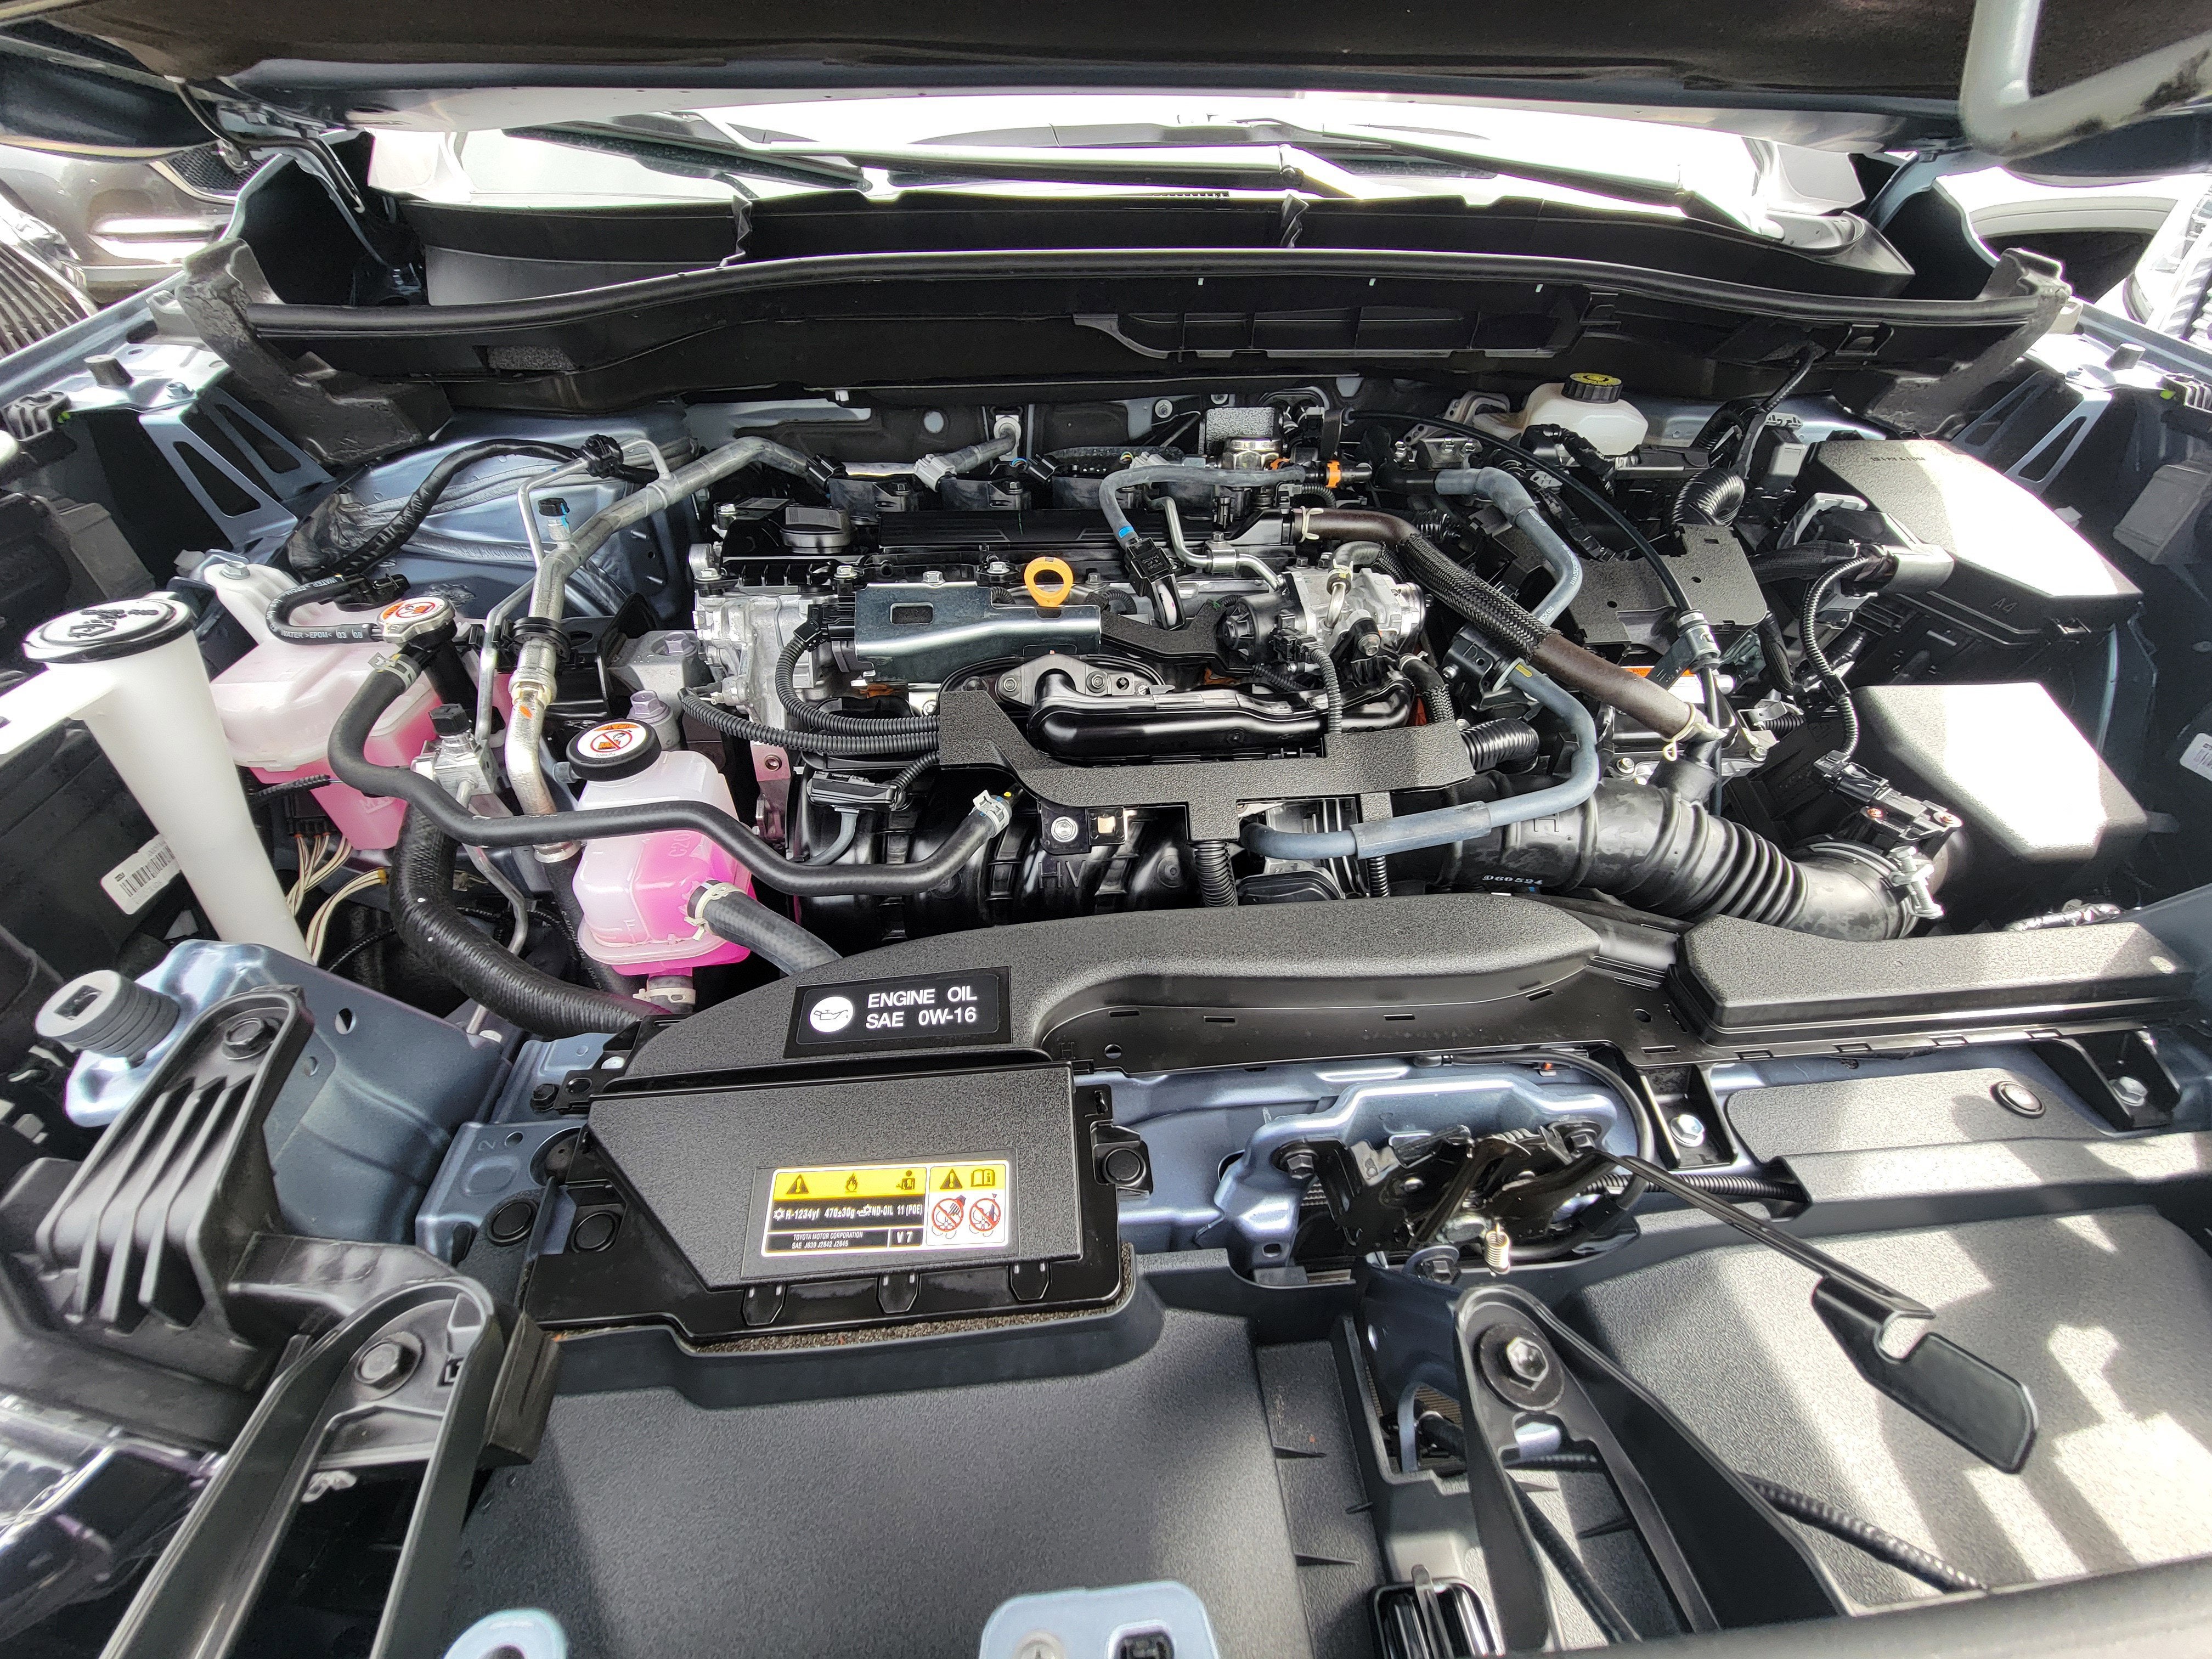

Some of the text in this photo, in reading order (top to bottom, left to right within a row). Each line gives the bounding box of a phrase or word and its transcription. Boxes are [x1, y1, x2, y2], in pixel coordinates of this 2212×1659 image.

[1990, 598, 2017, 613] A4
[1038, 860, 1086, 889] HV
[867, 985, 977, 1008] ENGINE OIL
[866, 1006, 977, 1029] SAE 0W-16
[785, 1208, 820, 1220] R-1234yf
[824, 1207, 855, 1219] 470±30g
[897, 1204, 904, 1215] 11
[906, 1204, 923, 1216] (POE)
[830, 1231, 864, 1239] CORPORATION
[896, 1231, 913, 1244] V 7
